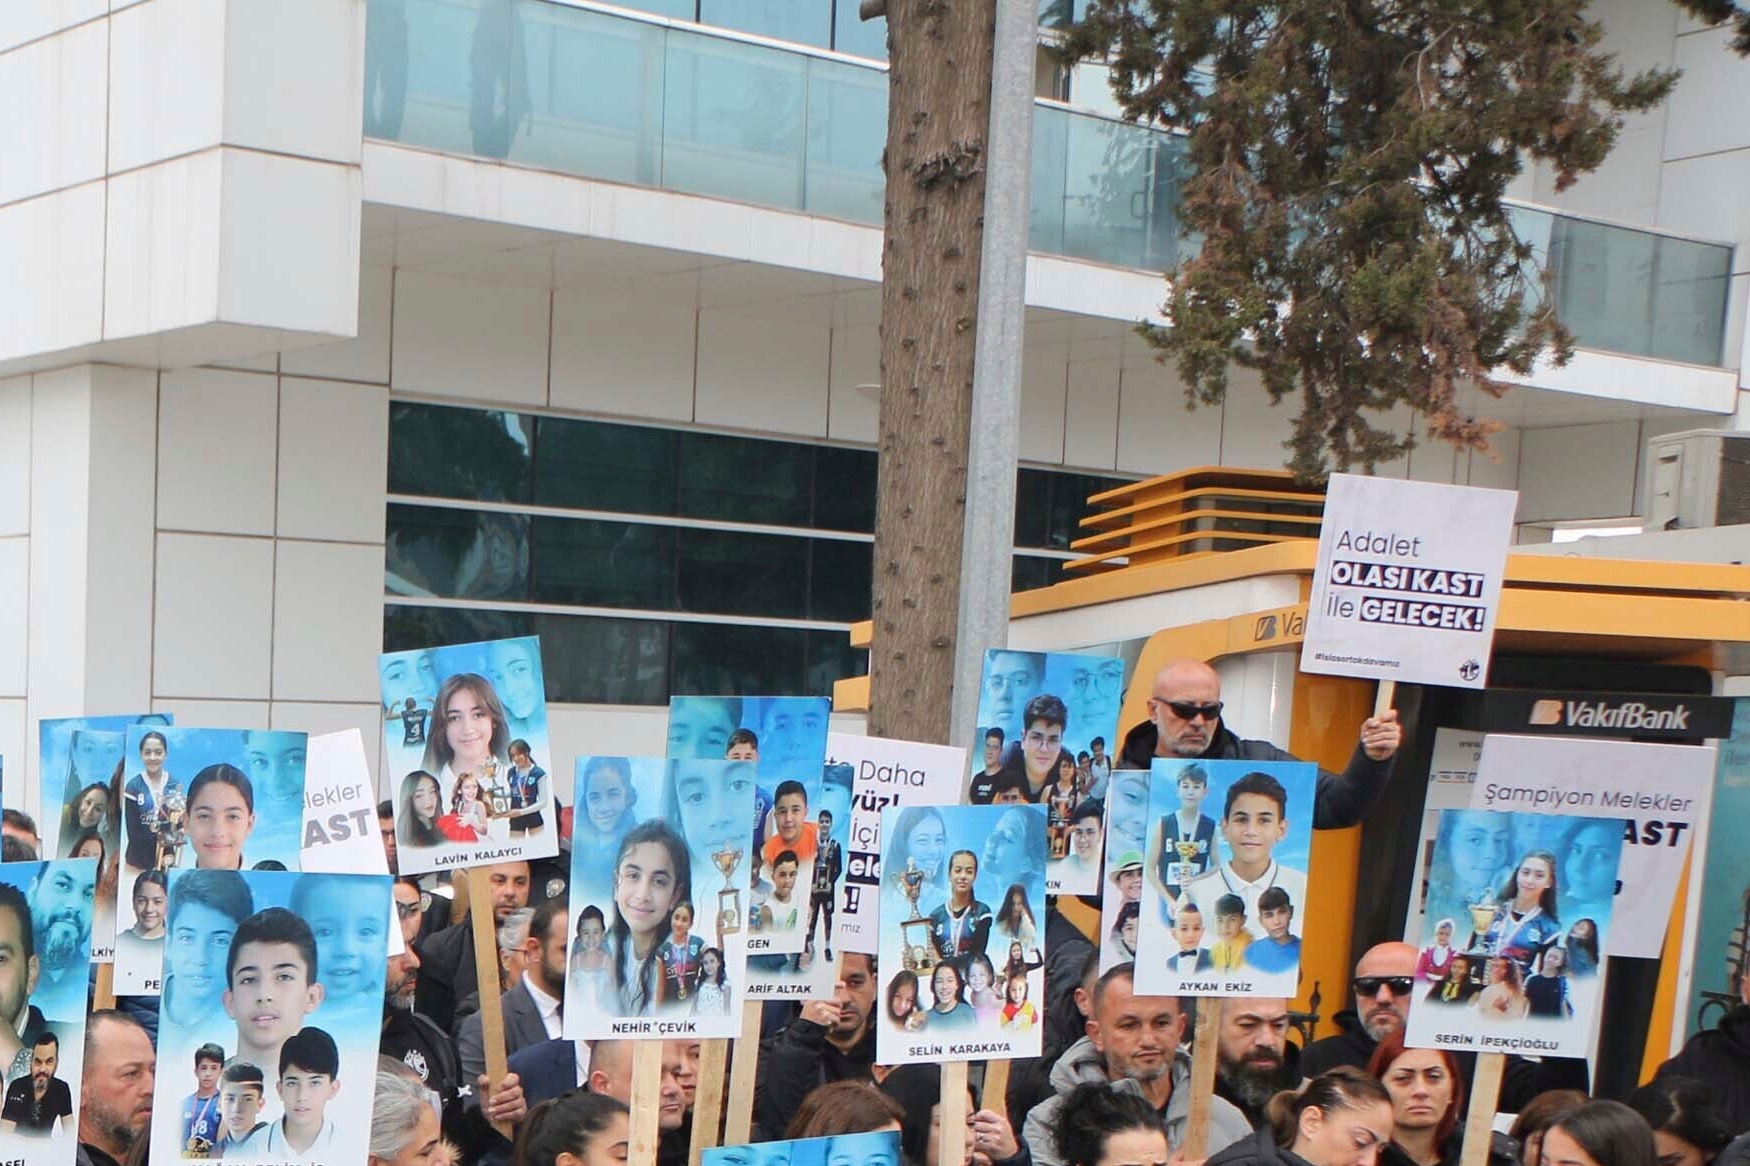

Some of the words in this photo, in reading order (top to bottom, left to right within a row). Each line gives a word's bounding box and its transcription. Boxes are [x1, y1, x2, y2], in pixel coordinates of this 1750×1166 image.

[1336, 530, 1421, 558] Adalet
[1331, 563, 1407, 589] OLASI
[1414, 569, 1484, 597] KAST
[1360, 599, 1485, 631] GELECEK!
[1565, 701, 1690, 731] VakıfBank
[859, 760, 925, 787] Daha
[305, 782, 363, 811] lekler
[1484, 783, 1595, 810] Şampiyon
[1600, 790, 1692, 812] Melekler
[303, 808, 372, 849] AST
[1623, 819, 1690, 847] AST
[434, 852, 469, 866] LAVİN
[475, 847, 523, 861] KALAYCI
[747, 939, 770, 949] GEN
[748, 983, 774, 994] ARİF
[776, 985, 811, 994] ALTAK
[1179, 982, 1218, 992] AYKAN
[1225, 982, 1253, 992] EKİZ
[612, 1022, 651, 1034] NEHİR
[659, 1021, 697, 1035] ÇEVİK
[908, 1045, 944, 1057] SELİN
[949, 1041, 1011, 1056] KARAKAYA
[1435, 1033, 1473, 1045] SERİN
[1481, 1034, 1559, 1051] İPEKÇİOĞLU
